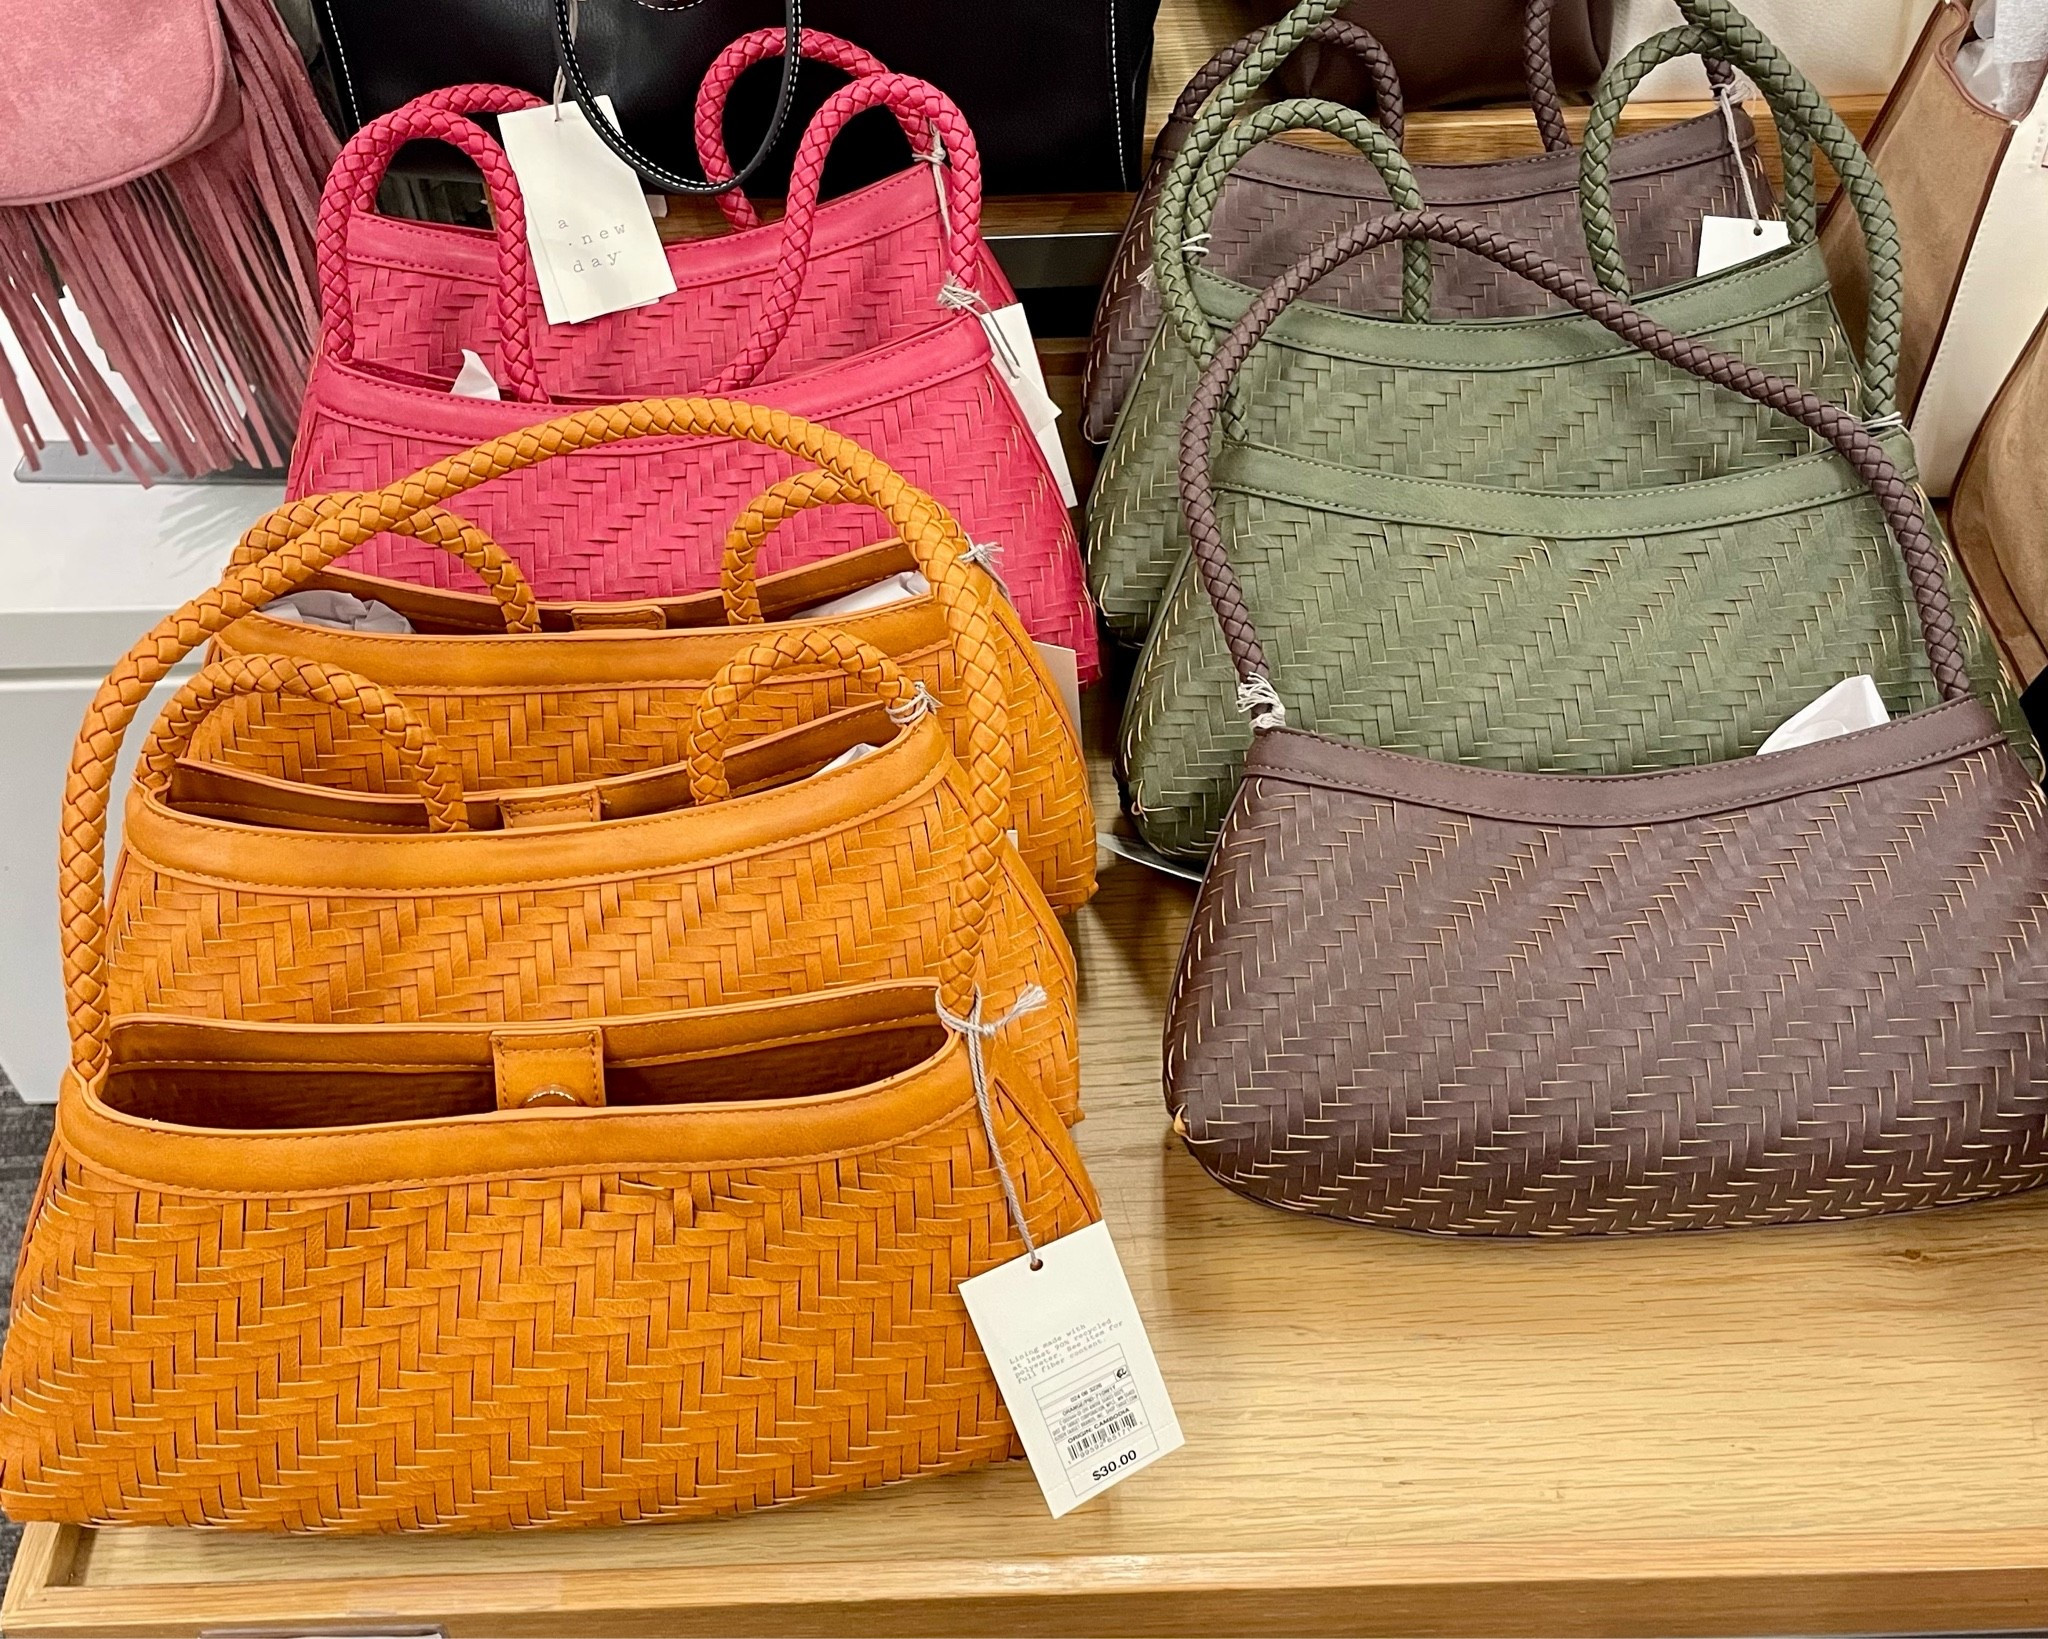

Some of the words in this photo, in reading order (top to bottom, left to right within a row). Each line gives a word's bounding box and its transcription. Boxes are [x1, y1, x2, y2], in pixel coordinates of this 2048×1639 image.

[558, 219, 569, 229] a
[1093, 1407, 1129, 1429] CAMBODIA
[1092, 1449, 1136, 1480] $30.00
